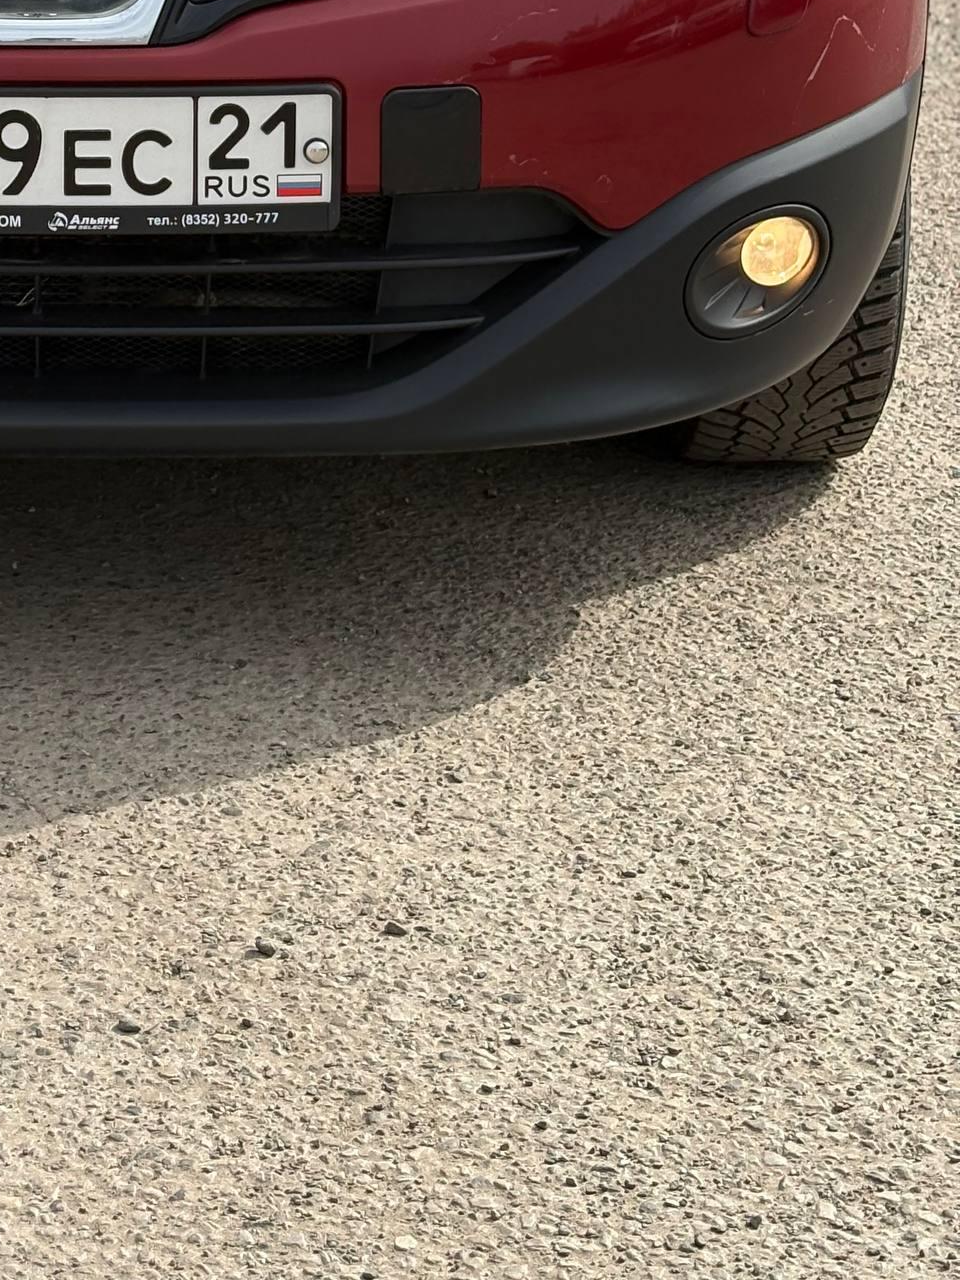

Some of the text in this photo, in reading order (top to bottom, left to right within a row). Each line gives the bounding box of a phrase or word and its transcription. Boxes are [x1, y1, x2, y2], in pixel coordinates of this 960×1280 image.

[208, 101, 297, 170] 21
[204, 175, 271, 198] RUS
[69, 214, 120, 225] Альянс
[146, 212, 279, 227] тел.: (8352) 320-777
